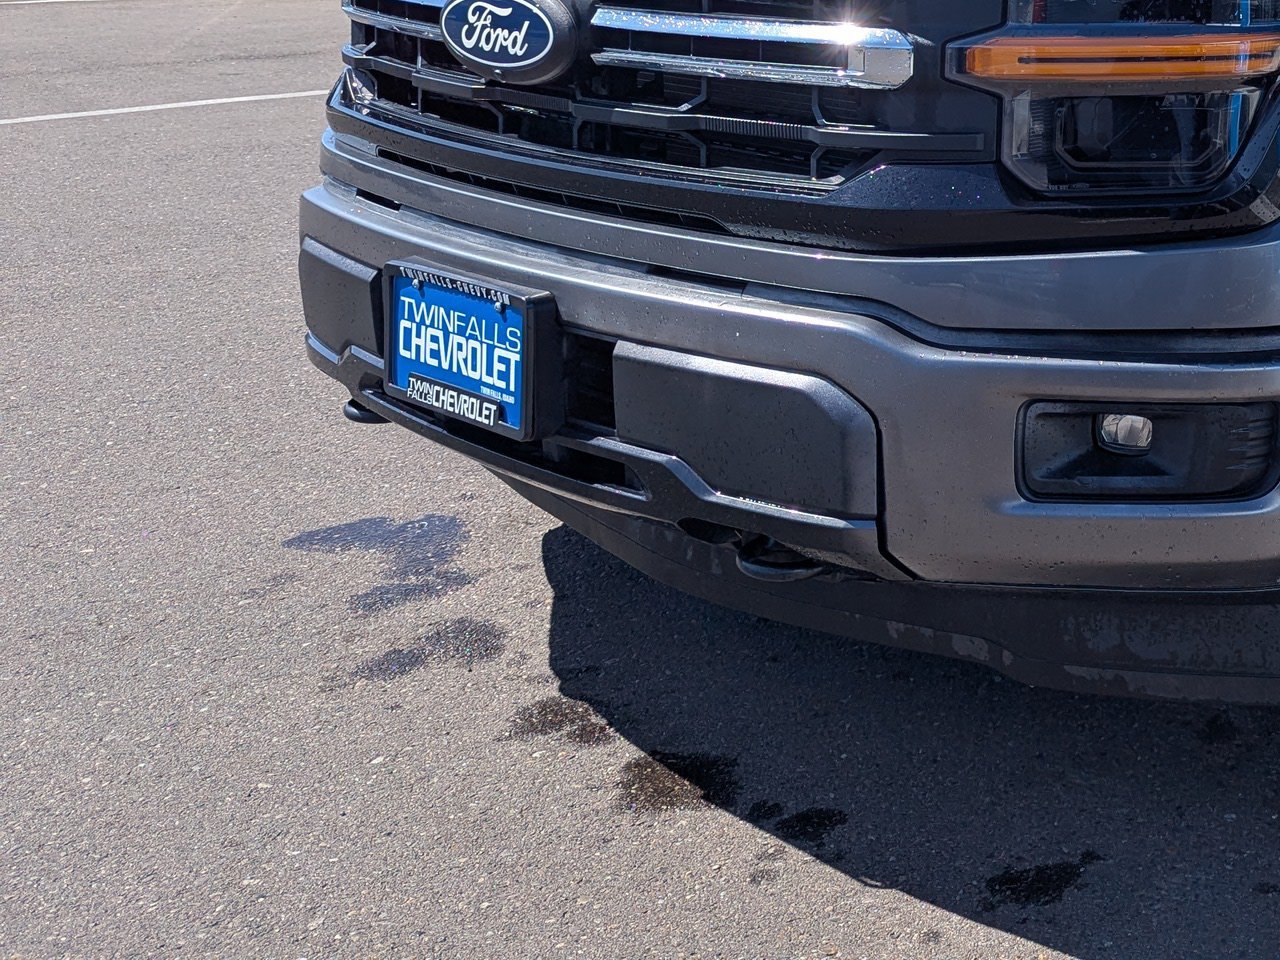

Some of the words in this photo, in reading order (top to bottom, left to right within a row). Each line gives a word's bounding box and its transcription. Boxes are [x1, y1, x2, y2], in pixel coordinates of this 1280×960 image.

[461, 1, 531, 57] Ford
[399, 266, 511, 306] TWINFALLS-CHEVY.COM
[399, 319, 521, 392] CHEVROLET
[407, 389, 432, 405] FALLS
[432, 385, 498, 426] CHEVROLET
[408, 377, 433, 394] TWIN
